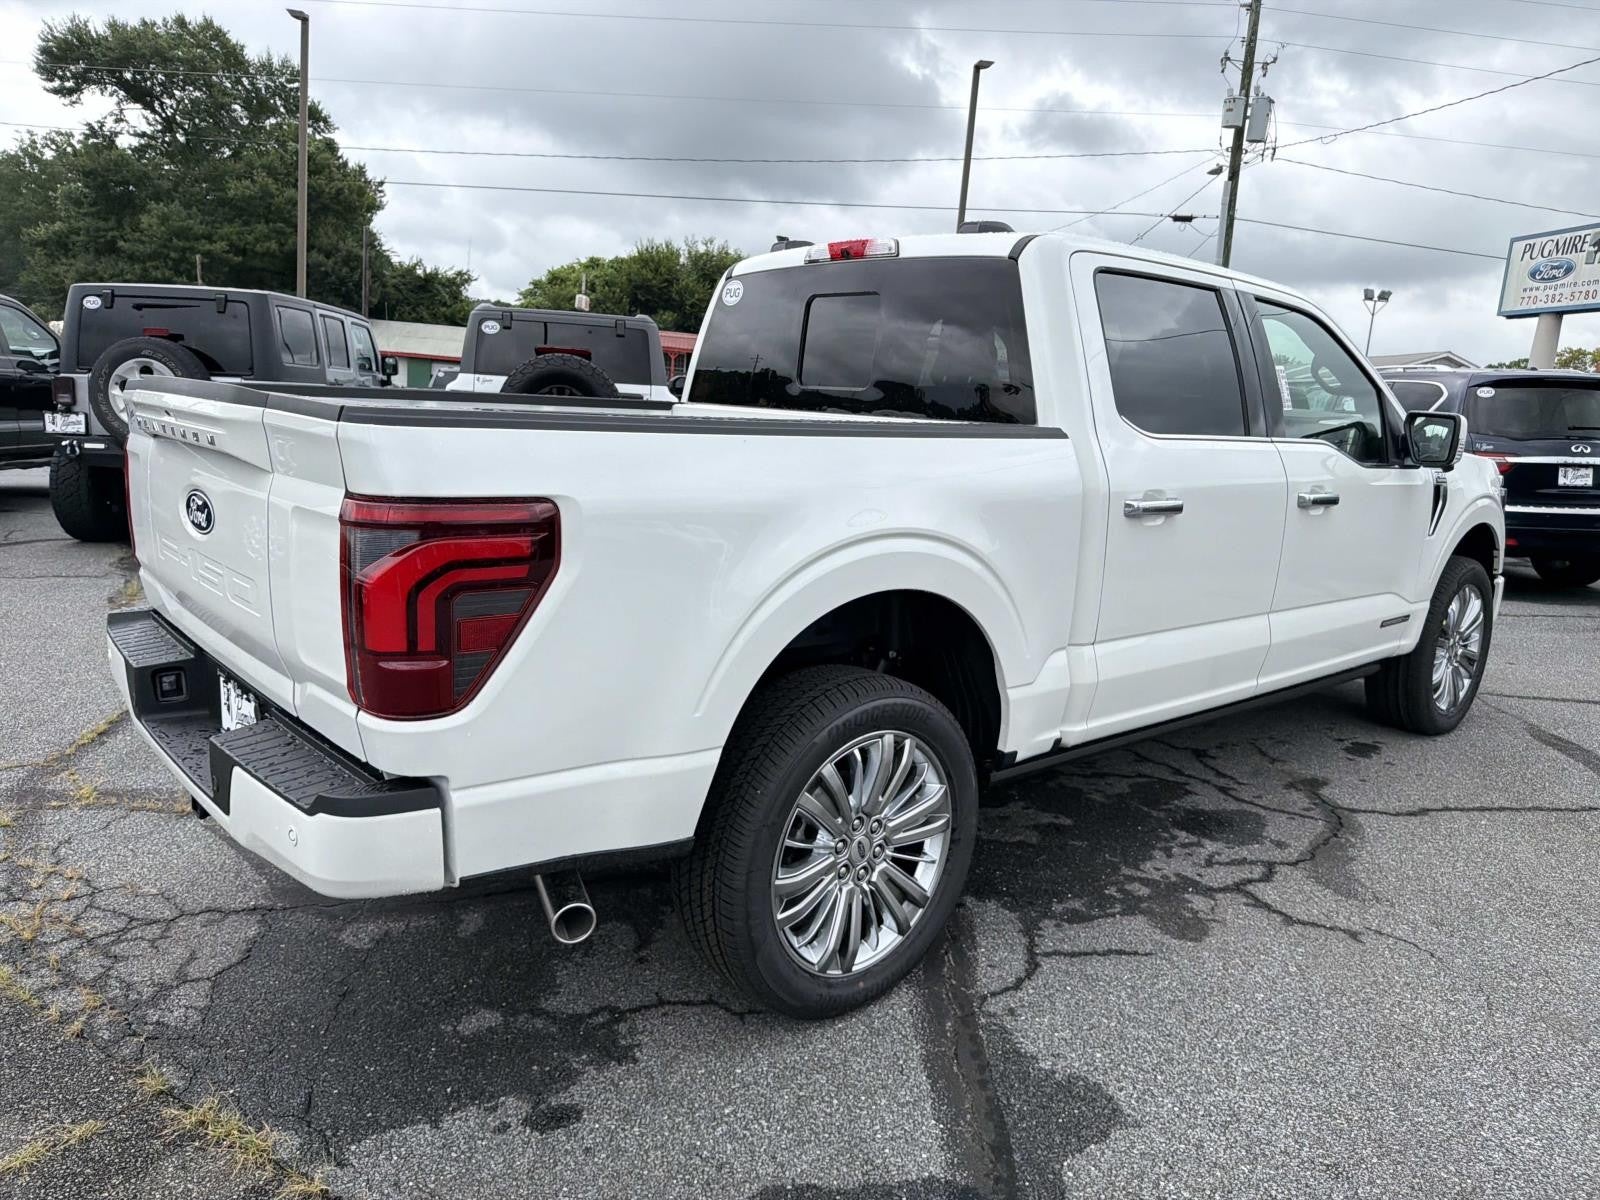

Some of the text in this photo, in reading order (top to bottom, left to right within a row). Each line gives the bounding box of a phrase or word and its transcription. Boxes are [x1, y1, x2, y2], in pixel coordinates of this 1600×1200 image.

[1520, 233, 1591, 262] PUGMIRE
[1535, 262, 1567, 280] Ford
[725, 287, 740, 298] PUG
[1522, 279, 1600, 293] www.pugmire.com
[1520, 289, 1598, 307] 770-382-5780
[188, 495, 208, 528] Ford
